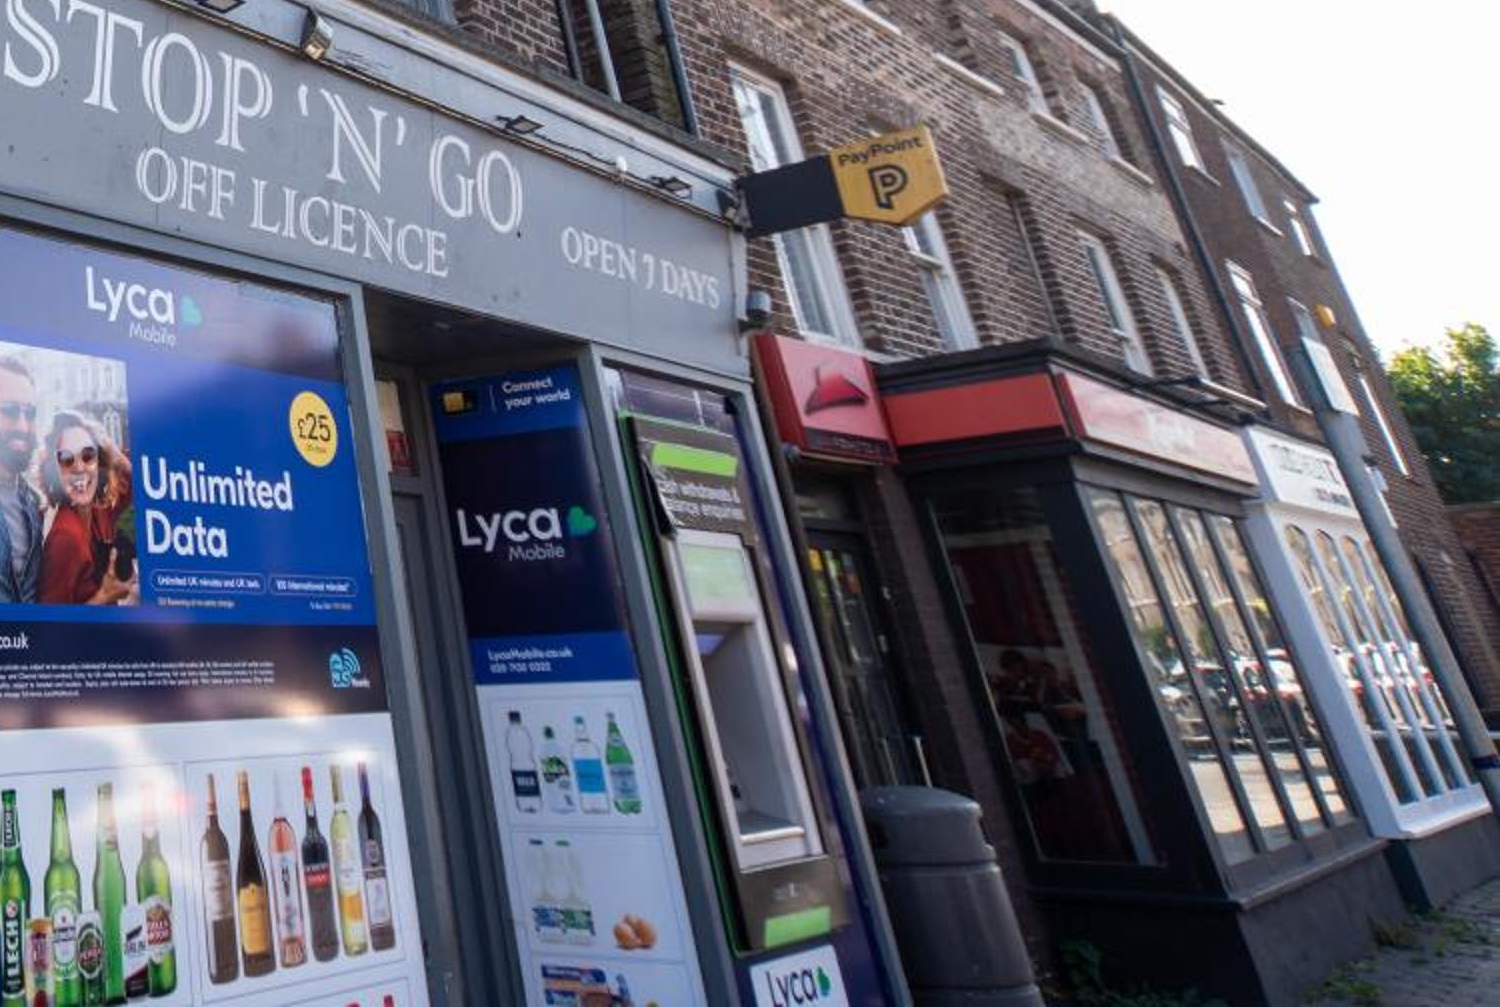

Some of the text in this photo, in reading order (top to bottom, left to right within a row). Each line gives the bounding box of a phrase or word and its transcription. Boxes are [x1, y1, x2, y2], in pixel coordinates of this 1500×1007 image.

[838, 136, 923, 167] PayPoint
[430, 134, 523, 234] GO
[136, 146, 449, 277] OFF LICENCE
[561, 226, 720, 309] OPEN 7 DAYS
[85, 265, 176, 325] Lyca
[128, 322, 177, 347] Mobile
[501, 377, 553, 393] Connect
[505, 388, 571, 411] your world
[141, 455, 294, 511] Unlimited
[145, 508, 229, 558] Data
[456, 508, 563, 553] Lyca
[508, 543, 565, 562] Mobile
[6, 919, 21, 978] LECH
[765, 967, 819, 1007] Lyca
